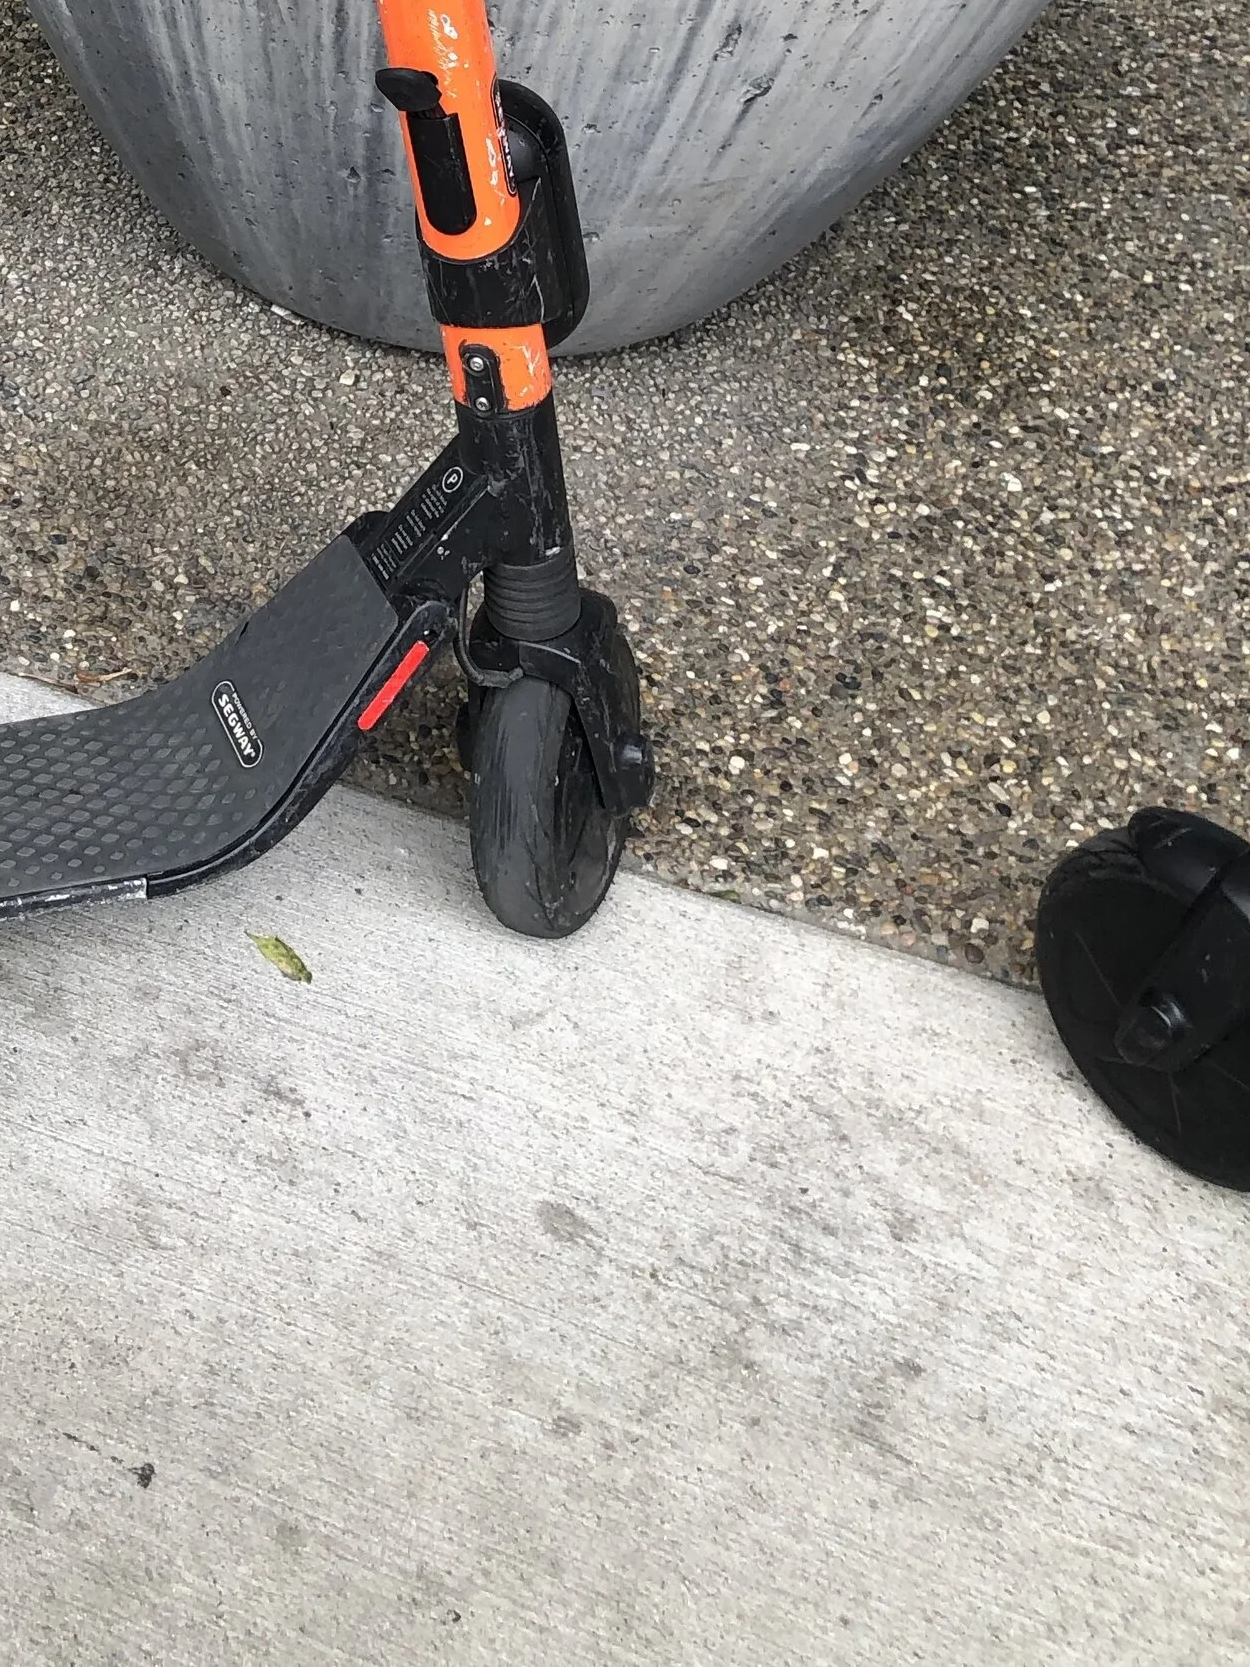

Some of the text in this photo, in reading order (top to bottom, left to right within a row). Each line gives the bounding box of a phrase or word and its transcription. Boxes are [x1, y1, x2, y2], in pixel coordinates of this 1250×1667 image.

[218, 693, 254, 756] SEGWAY
[232, 692, 258, 740] POWERED BY
